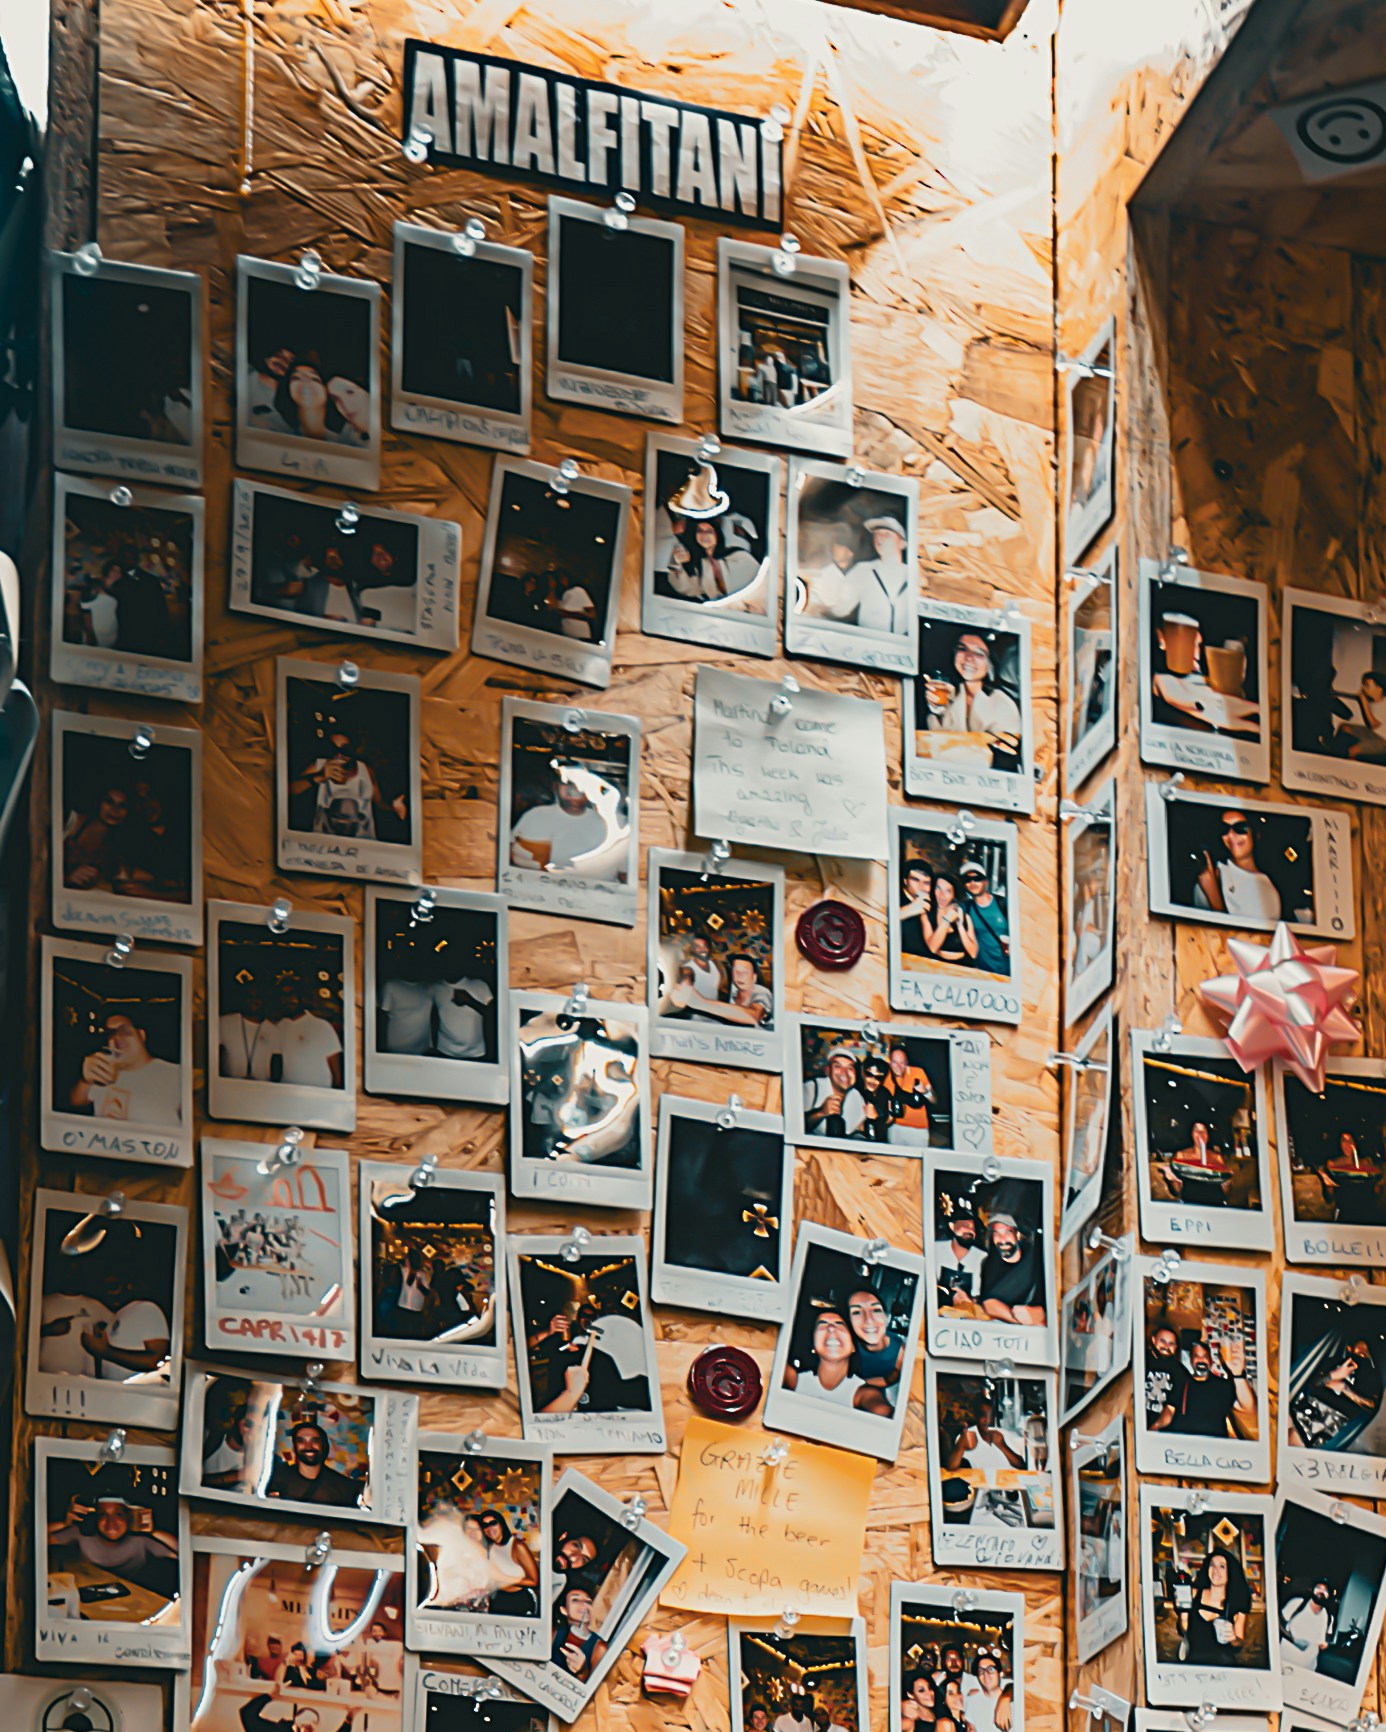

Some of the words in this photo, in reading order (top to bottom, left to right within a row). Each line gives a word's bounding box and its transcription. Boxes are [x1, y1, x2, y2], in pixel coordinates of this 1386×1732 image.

[410, 50, 783, 224] AMALFITANI
[932, 983, 1019, 1014] CALDOOO
[935, 1329, 983, 1350] CIAO
[690, 1495, 713, 1528] for
[737, 1514, 767, 1537] the
[781, 1520, 828, 1546] beer
